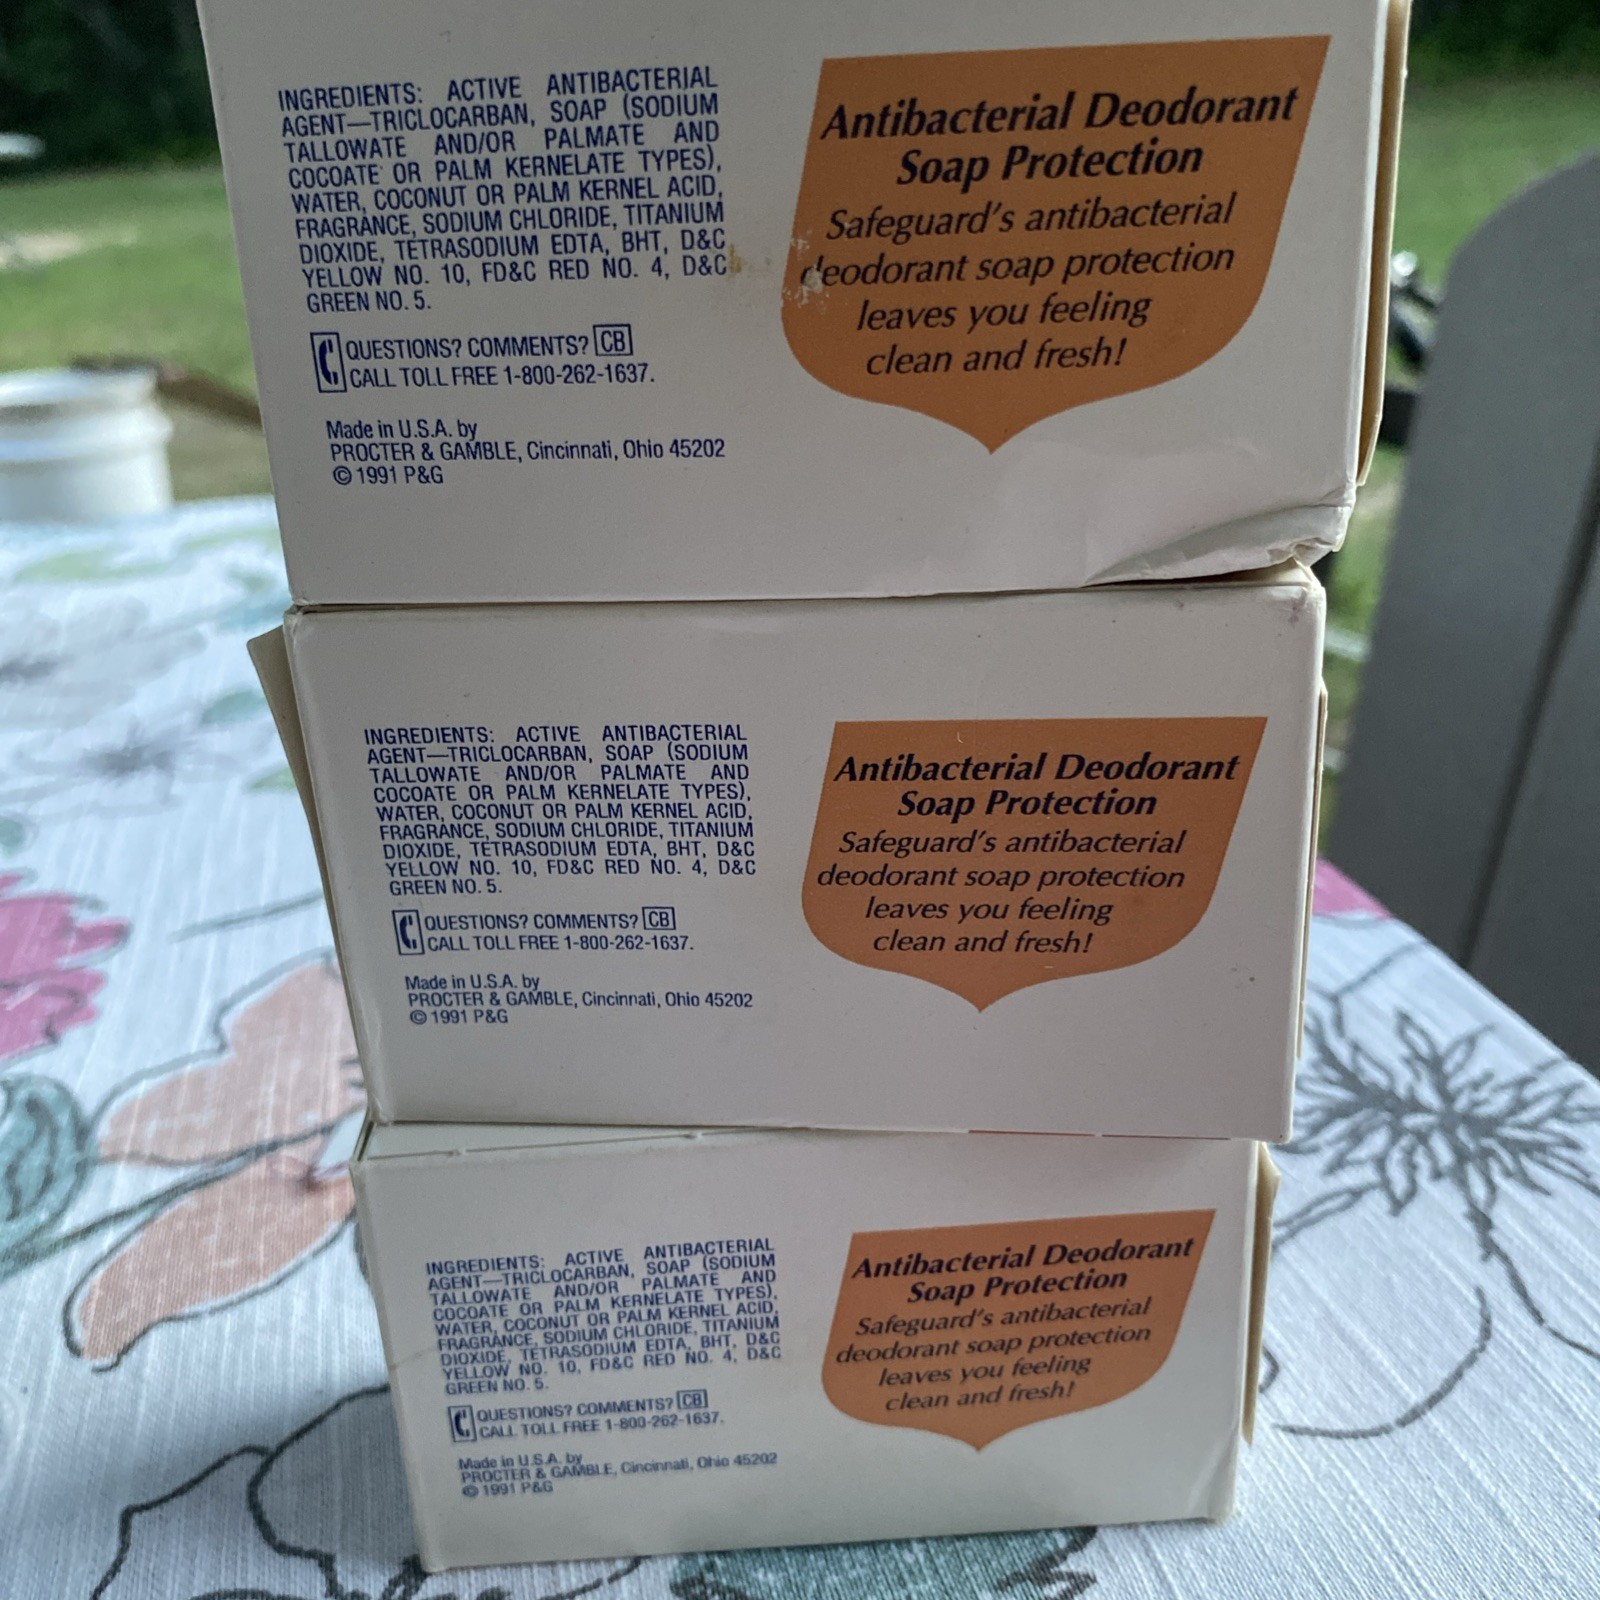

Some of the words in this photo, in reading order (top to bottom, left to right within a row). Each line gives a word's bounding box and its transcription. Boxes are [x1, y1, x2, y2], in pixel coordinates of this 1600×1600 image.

[278, 82, 422, 111] INGREDIENTS:
[447, 76, 521, 102] ACTIVE
[547, 66, 717, 96] ANTIBACTERIAL
[550, 98, 606, 123] SOAP
[623, 92, 718, 120] (SODIUM
[820, 90, 1076, 140] Antibacterial
[1084, 85, 1298, 128] Deodorant
[283, 136, 406, 163] TALLOWATE
[434, 130, 516, 155] AND/OR
[544, 123, 644, 150] PALMATE
[674, 120, 719, 143] AND
[288, 164, 379, 189] COCOATE
[393, 161, 421, 184] OR
[435, 158, 492, 182] PALM
[505, 151, 625, 178] KERNELATE
[638, 145, 721, 172] TYPES),
[897, 149, 990, 194] Soap
[1001, 136, 1204, 180] Protection
[291, 191, 366, 214] WATER,
[374, 185, 466, 211] COCONUT
[476, 184, 505, 206] OR
[514, 180, 570, 204] PALM
[579, 177, 659, 201] KERNEL
[667, 174, 722, 198] ACID,
[295, 214, 416, 239] FRAGRANCE,
[422, 210, 502, 234] SODIUM
[509, 205, 617, 231] CHLORIDE,
[623, 201, 724, 225] TITANIUM
[826, 200, 1015, 245] Safeguard's
[1025, 191, 1237, 231] antibacterial
[299, 241, 385, 265] DIOXIDE,
[394, 234, 539, 260] TETRASODIUM
[550, 232, 609, 256] EDTA,
[621, 230, 668, 255] BHT,
[681, 228, 725, 251] D&C
[302, 266, 382, 288] YELLOW
[394, 264, 429, 285] NO.
[441, 263, 470, 286] 10,
[482, 260, 536, 282] FD&C
[548, 258, 589, 280] RED
[602, 257, 638, 279] NO.
[651, 256, 669, 280] 4,
[682, 254, 727, 276] D&C
[976, 256, 1055, 286] soap
[1061, 242, 1235, 285] protection
[306, 291, 370, 313] GREEN
[375, 290, 409, 311] NO.
[413, 289, 431, 310] 5.
[857, 299, 957, 331] leaves
[967, 304, 1029, 334] you
[1039, 290, 1153, 328] feeling
[345, 338, 462, 360] QUESTIONS?
[467, 335, 589, 358] COMMENTS?
[601, 331, 626, 353] CB
[866, 343, 953, 375] clean
[963, 339, 1028, 372] and
[1034, 335, 1127, 369] fresh!
[350, 368, 397, 388] CALL
[399, 367, 449, 387] TOLL
[451, 366, 498, 386] FREE
[504, 362, 654, 385] 1-800-262-1637.
[326, 420, 374, 439] Made
[377, 419, 394, 439] in
[398, 418, 453, 439] U.S.A.
[457, 419, 477, 441] by
[330, 442, 415, 462] PROCTER
[421, 442, 435, 461] &
[440, 441, 522, 463] GAMBLE,
[527, 440, 618, 461] Cincinnati,
[623, 439, 663, 459] Ohio
[669, 438, 725, 458] 45202
[356, 465, 397, 485] 1991
[403, 465, 444, 484] P&G
[364, 726, 494, 745] INGREDIENTS:
[516, 726, 581, 743] ACTIVE
[602, 724, 747, 742] ANTIBACTERIAL
[605, 744, 653, 761] SOAP
[667, 742, 748, 761] (SODIUM
[833, 752, 1048, 781] Antibacterial
[1055, 751, 1240, 780] Deodorant
[369, 766, 481, 784] TALLOWATE
[505, 764, 576, 781] AND/OR
[600, 764, 686, 780] PALMATE
[711, 764, 749, 780] AND
[373, 785, 457, 803] COCOATE
[468, 784, 494, 801] OR
[506, 784, 556, 800] PALM
[567, 783, 670, 800] KERNELATE
[680, 781, 751, 801] TYPES),
[897, 790, 975, 824] Soap
[985, 787, 1157, 815] Protection
[838, 829, 997, 859] Safeguard's
[1005, 828, 1187, 853] antibacterial
[817, 863, 959, 886] deodorant
[964, 870, 1031, 892] soap
[1036, 865, 1185, 892] protection
[424, 914, 529, 931] QUESTIONS?
[533, 914, 639, 929] COMMENTS?
[648, 912, 670, 928] CB
[865, 896, 949, 919] leaves
[958, 904, 1010, 924] you
[1018, 896, 1114, 926] feeling
[427, 936, 470, 952] CALL
[473, 935, 515, 951] TOLL
[518, 935, 559, 950] FREE
[564, 935, 694, 950] 1-800-262-1637.
[873, 930, 946, 951] clean
[954, 930, 1009, 952] and
[1014, 930, 1093, 953] fresh!
[404, 975, 448, 990] Made
[451, 974, 466, 989] in
[470, 973, 518, 989] U.S.A.
[522, 974, 540, 992] by
[408, 991, 484, 1007] PROCTER
[489, 991, 501, 1006] &
[506, 991, 578, 1009] GAMBLE,
[582, 991, 661, 1008] Cincinnati,
[665, 992, 700, 1007] Ohio
[705, 992, 753, 1007] 45202
[431, 1009, 467, 1024] 1991
[473, 1008, 509, 1024] P&G
[851, 1244, 1037, 1278] Antibacterial
[1042, 1238, 1194, 1266] Deodorant
[907, 1281, 975, 1306] Soap
[983, 1268, 1128, 1297] Protection
[855, 1308, 994, 1337] Safeguard's
[1000, 1297, 1152, 1325] antibacterial
[835, 1340, 960, 1364] deodorant
[966, 1337, 1023, 1355] soap
[1027, 1325, 1151, 1354] protection
[878, 1368, 952, 1387] leaves
[960, 1365, 1004, 1384] you
[1011, 1355, 1092, 1377] feeling
[476, 1404, 573, 1423] QUESTIONS?
[576, 1397, 673, 1416] COMMENTS?
[885, 1392, 949, 1412] clean
[956, 1386, 1004, 1407] and
[1008, 1381, 1076, 1402] fresh!
[478, 1424, 517, 1439] CALL
[520, 1422, 560, 1436] TOLL
[562, 1419, 599, 1434] FREE
[605, 1411, 724, 1431] 1-800-262-1637.
